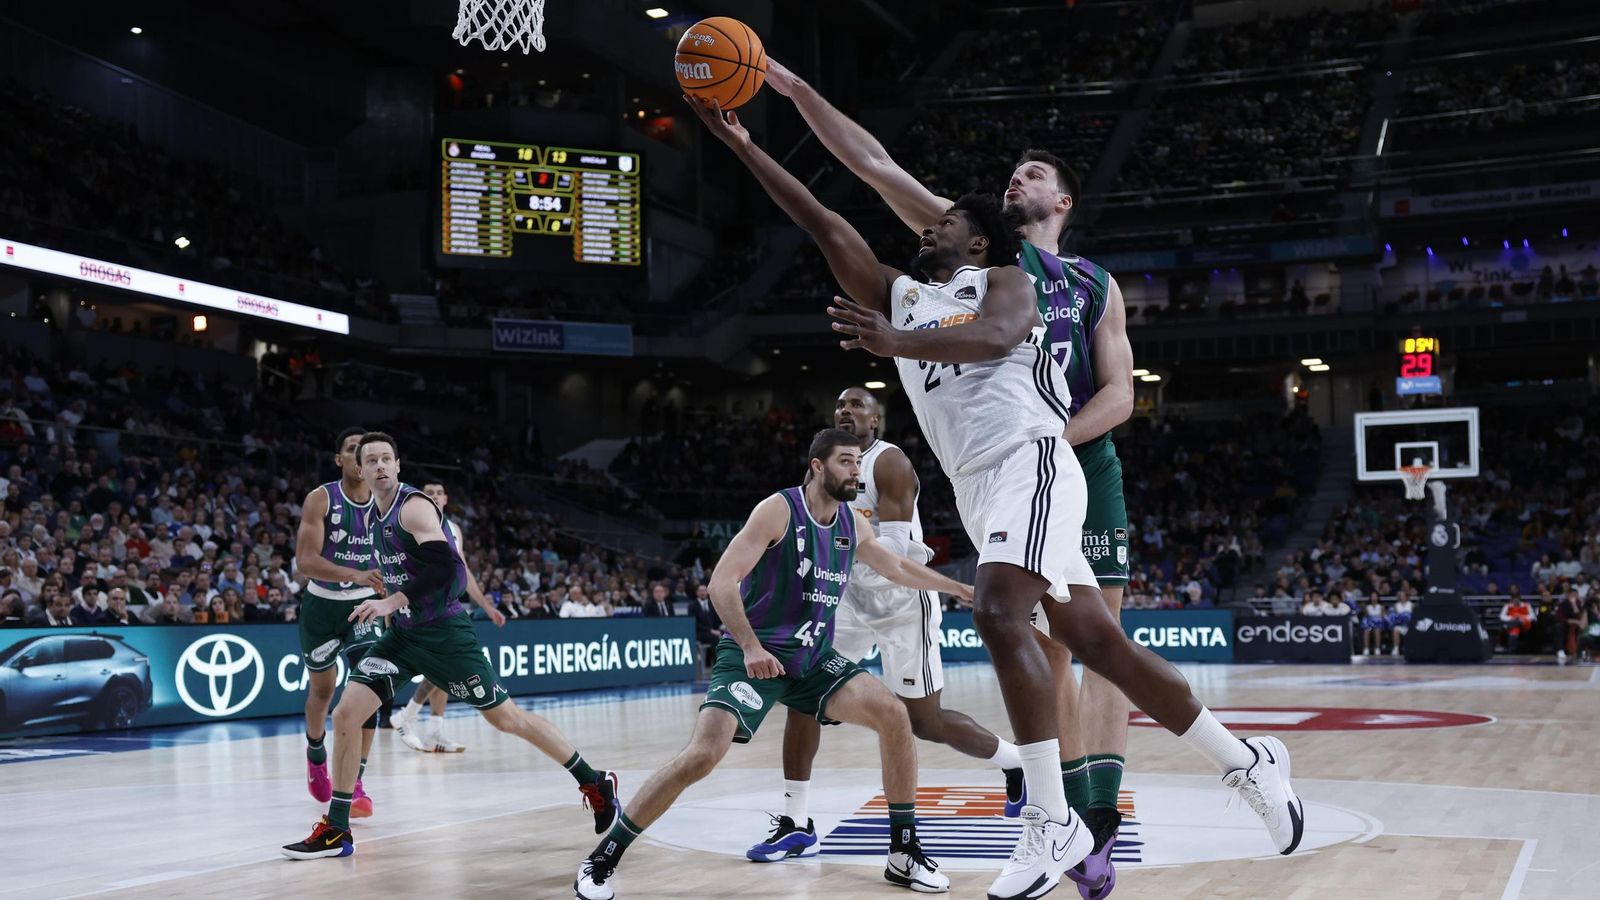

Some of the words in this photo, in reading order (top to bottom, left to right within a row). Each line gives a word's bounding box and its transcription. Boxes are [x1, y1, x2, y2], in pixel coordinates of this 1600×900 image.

[675, 62, 712, 79] Wilso
[529, 195, 562, 211] 8:54
[80, 261, 131, 285] DROGAS
[814, 566, 847, 585] Unicaja
[1133, 626, 1227, 648] CUENTA
[1237, 621, 1342, 643] endesa
[1434, 622, 1471, 633] Unicaja
[500, 645, 528, 677] DE
[534, 634, 622, 675] ENERGÍA
[625, 638, 693, 668] CUENTA
